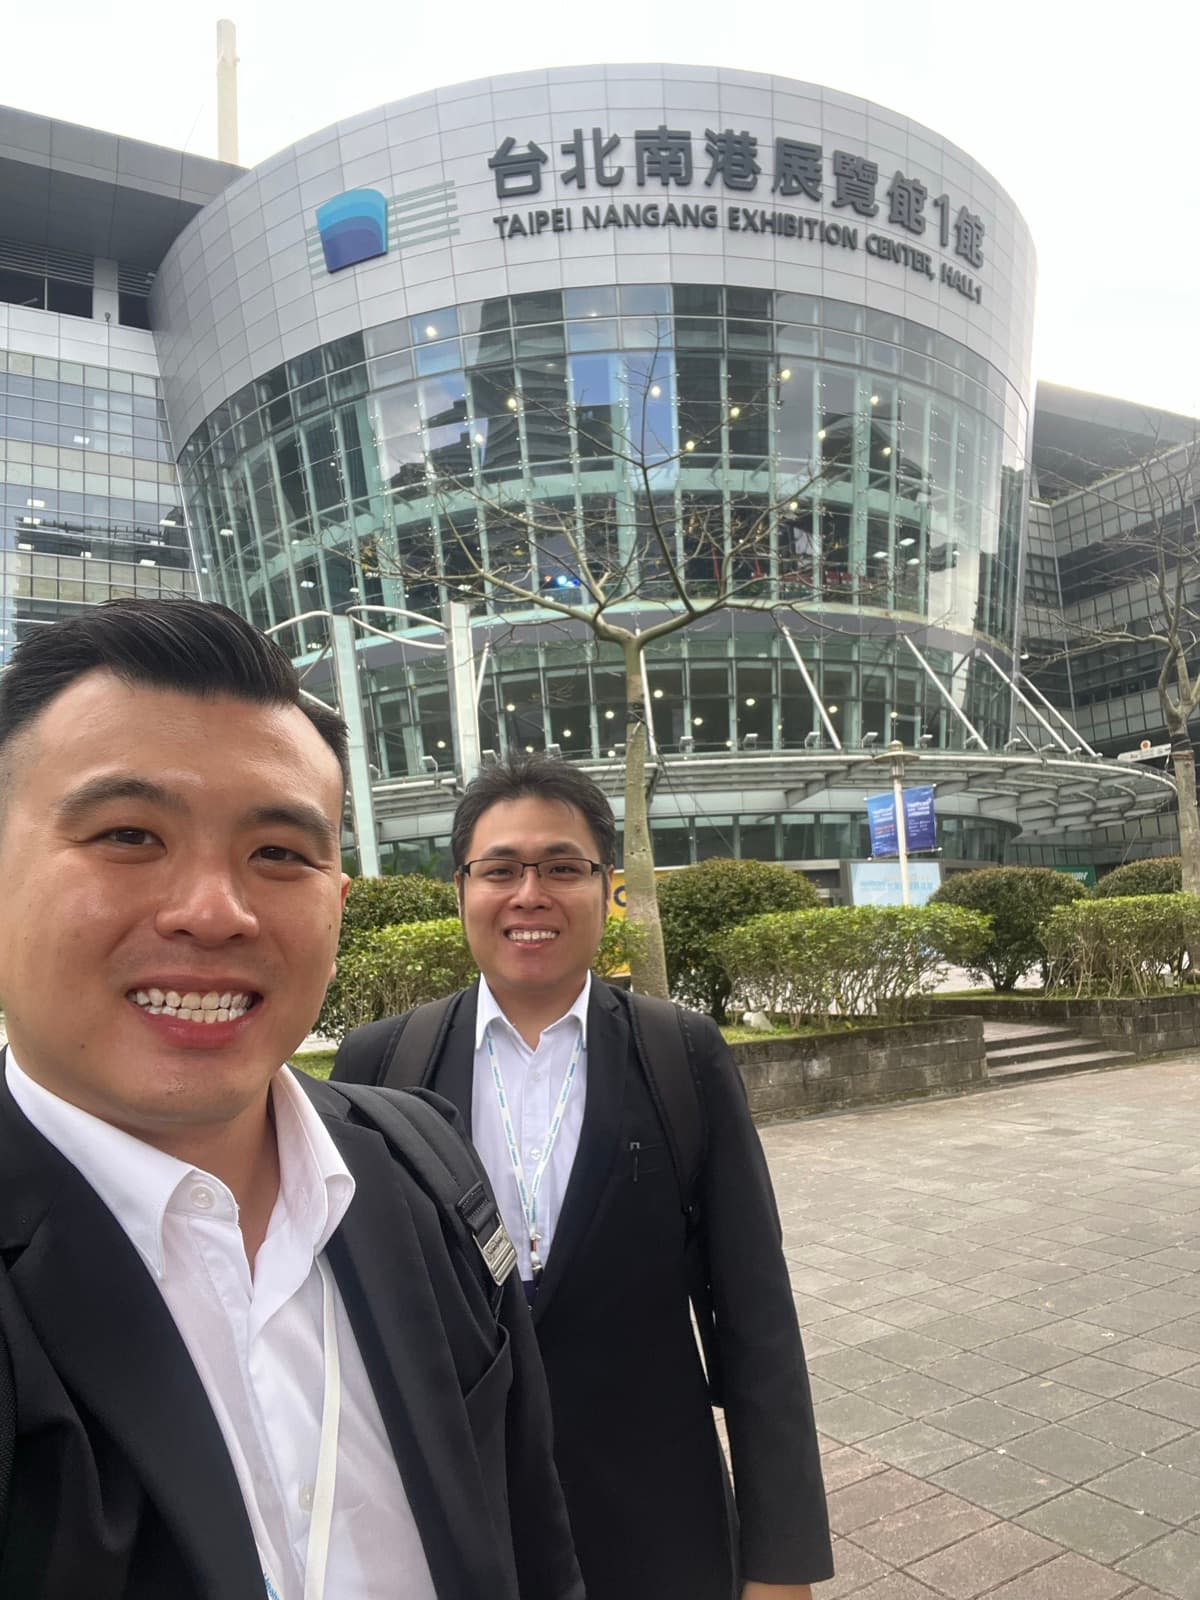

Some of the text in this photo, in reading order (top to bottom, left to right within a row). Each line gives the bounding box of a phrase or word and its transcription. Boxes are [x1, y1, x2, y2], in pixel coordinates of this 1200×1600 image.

[488, 124, 985, 269] 台北南港展覽館1館
[492, 206, 572, 240] TAIPEI
[582, 203, 718, 231] NANGANG
[727, 206, 858, 251] EXHIBITION
[865, 233, 936, 281] CENTER,
